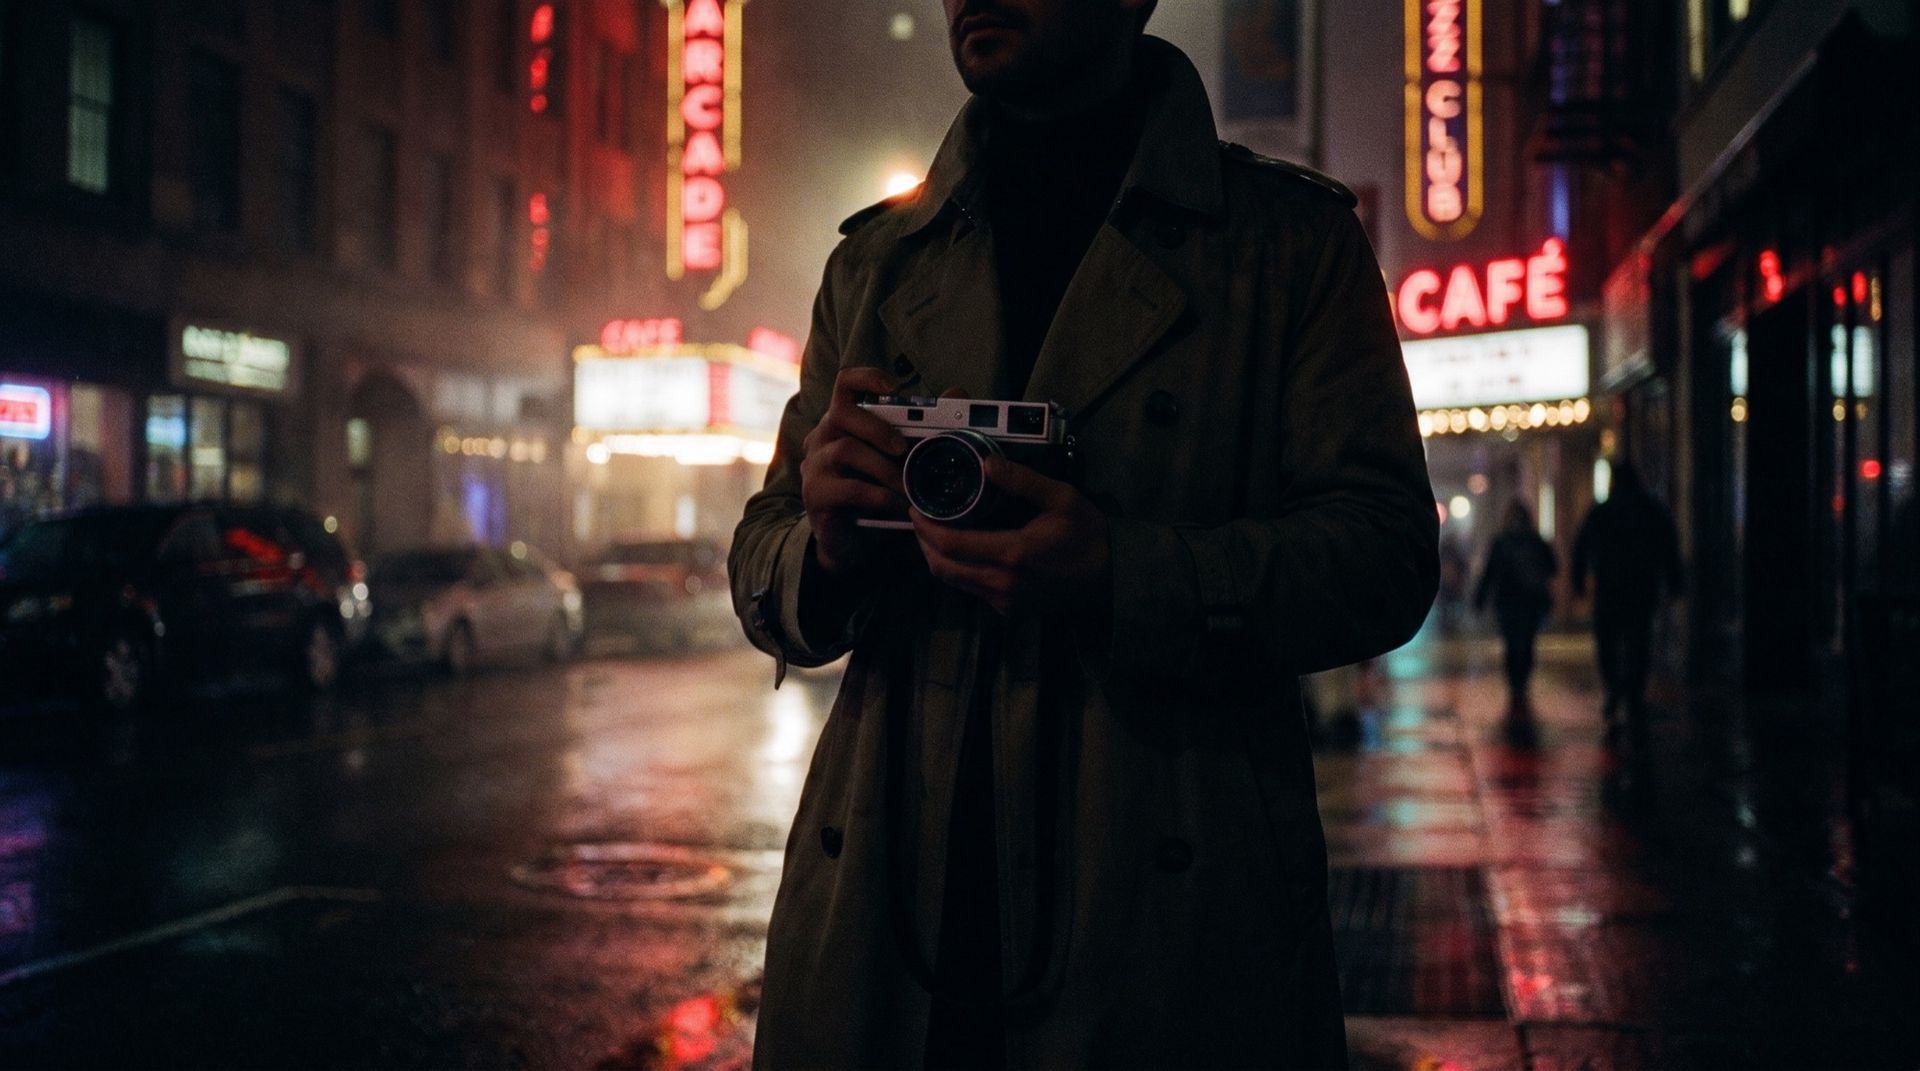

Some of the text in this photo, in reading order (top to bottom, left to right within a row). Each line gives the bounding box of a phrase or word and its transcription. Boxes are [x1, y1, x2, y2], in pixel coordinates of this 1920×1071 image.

[681, 0, 726, 272] ARCADE
[1426, 79, 1462, 222] CLUB
[1398, 237, 1568, 334] CAFÉ
